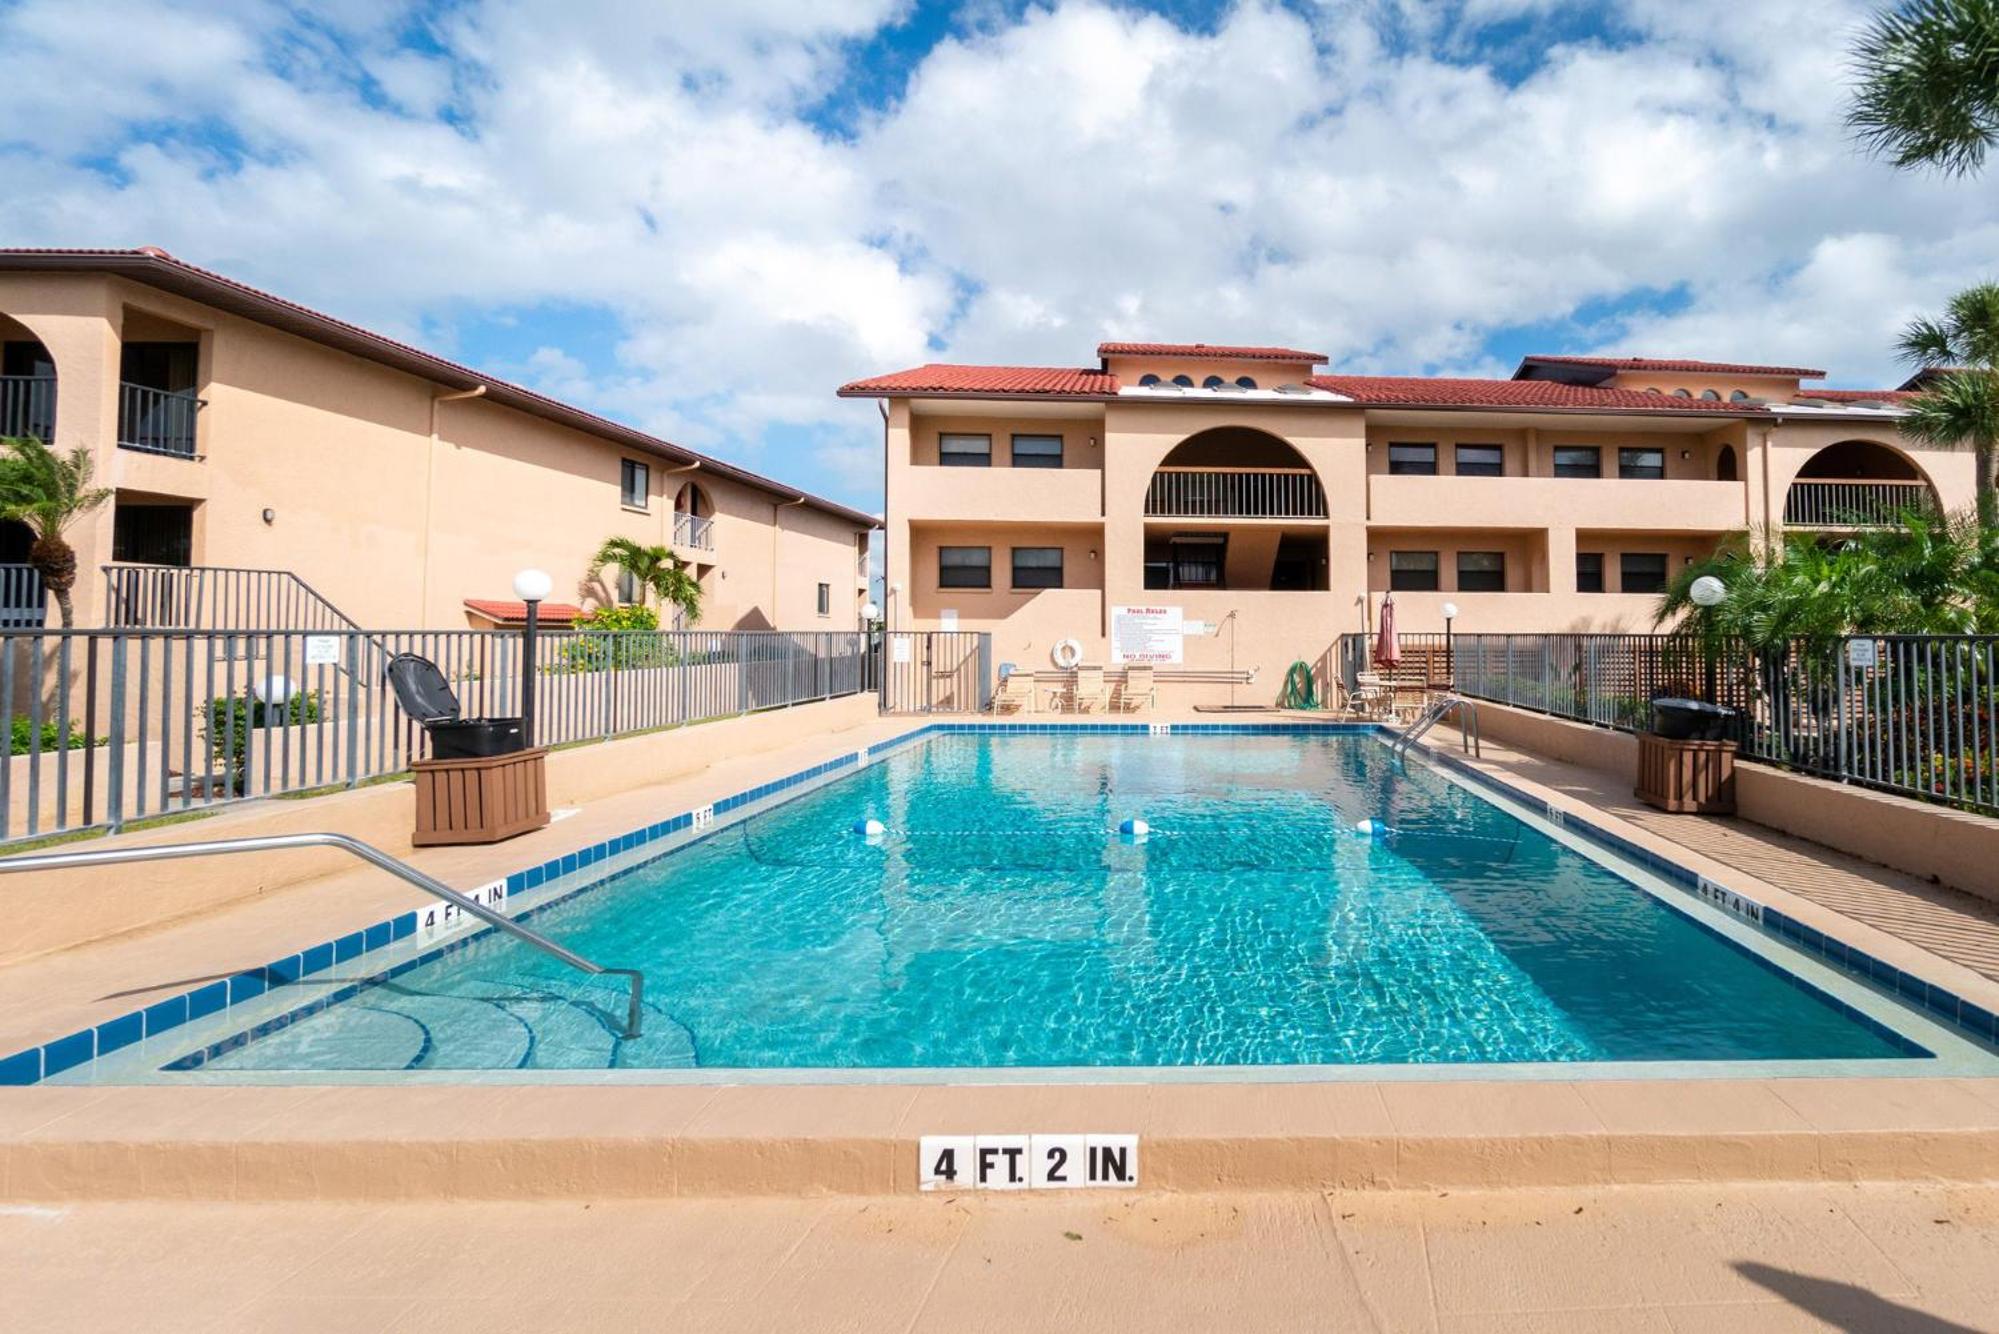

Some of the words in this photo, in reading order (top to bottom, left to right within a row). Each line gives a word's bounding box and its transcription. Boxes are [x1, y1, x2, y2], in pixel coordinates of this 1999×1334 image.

[425, 910, 435, 928] 4
[488, 884, 503, 904] IN
[1701, 882, 1708, 897] 4
[1713, 887, 1727, 904] FT
[1732, 897, 1740, 912] 4
[1746, 902, 1759, 921] IN
[934, 1148, 957, 1181] 4
[979, 1147, 1024, 1183] FT.
[1046, 1146, 1068, 1182] 2
[1089, 1146, 1135, 1182] IN.
